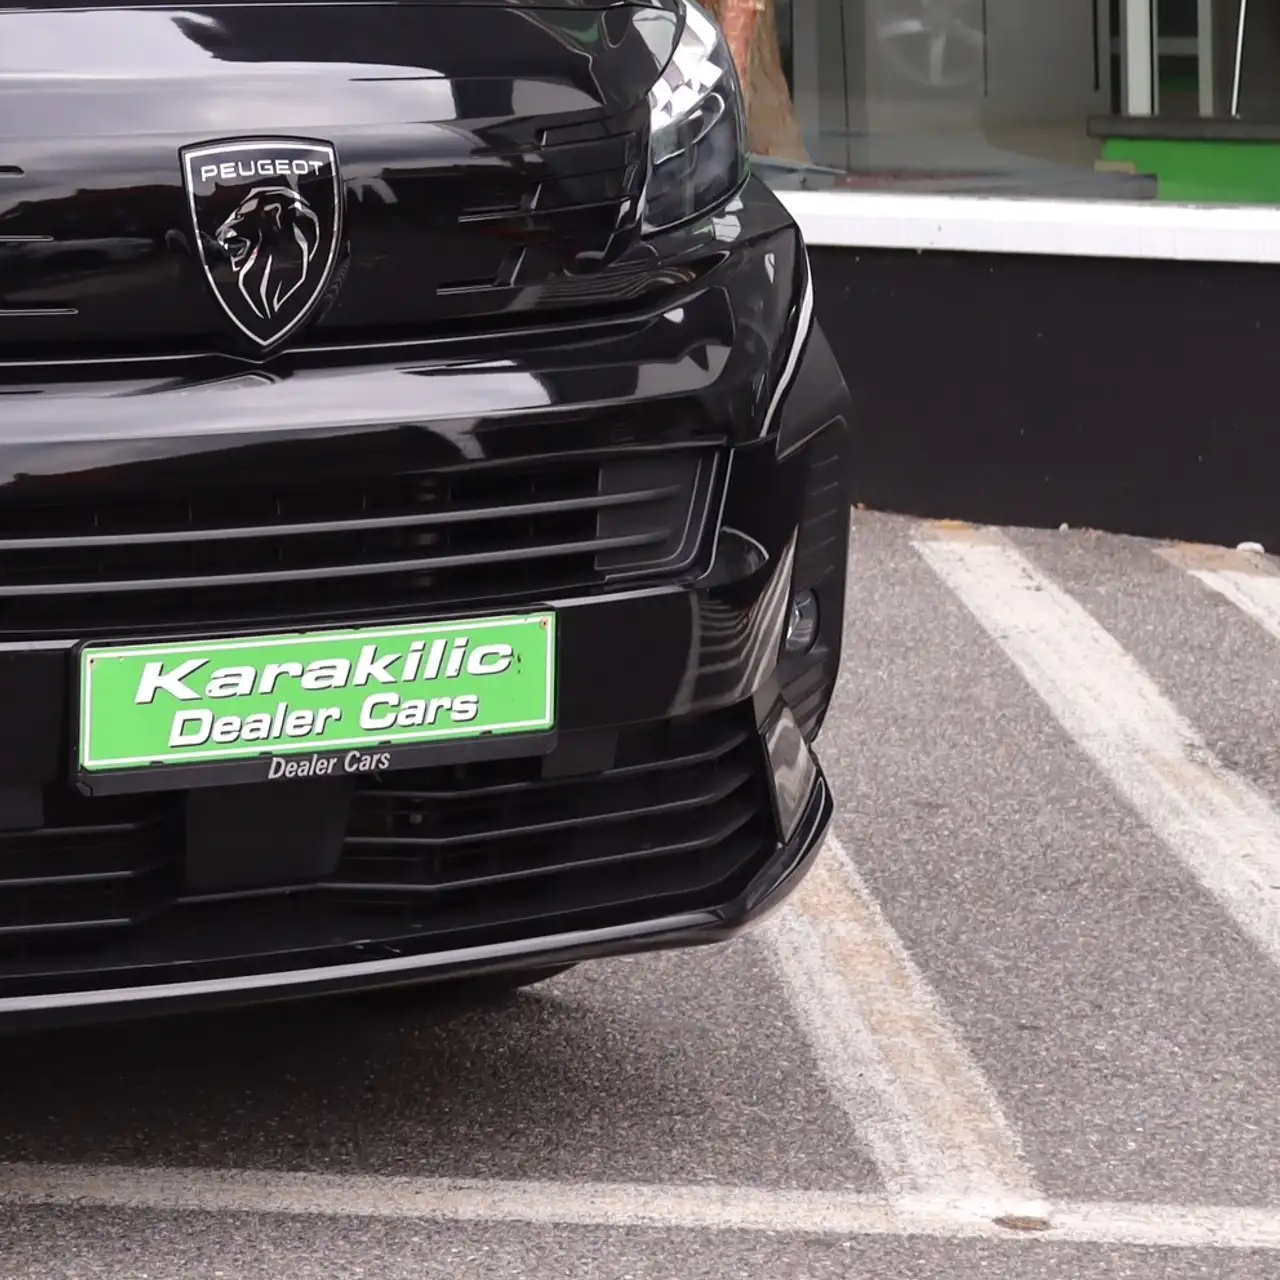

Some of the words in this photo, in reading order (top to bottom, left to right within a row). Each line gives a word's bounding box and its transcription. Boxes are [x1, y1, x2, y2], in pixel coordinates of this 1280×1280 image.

[200, 159, 324, 182] PEUGEOT
[134, 636, 514, 706] Karakilic
[168, 701, 342, 748] Dealer
[358, 692, 480, 732] Cars
[267, 751, 341, 780] Dealer
[343, 750, 391, 773] Cars
